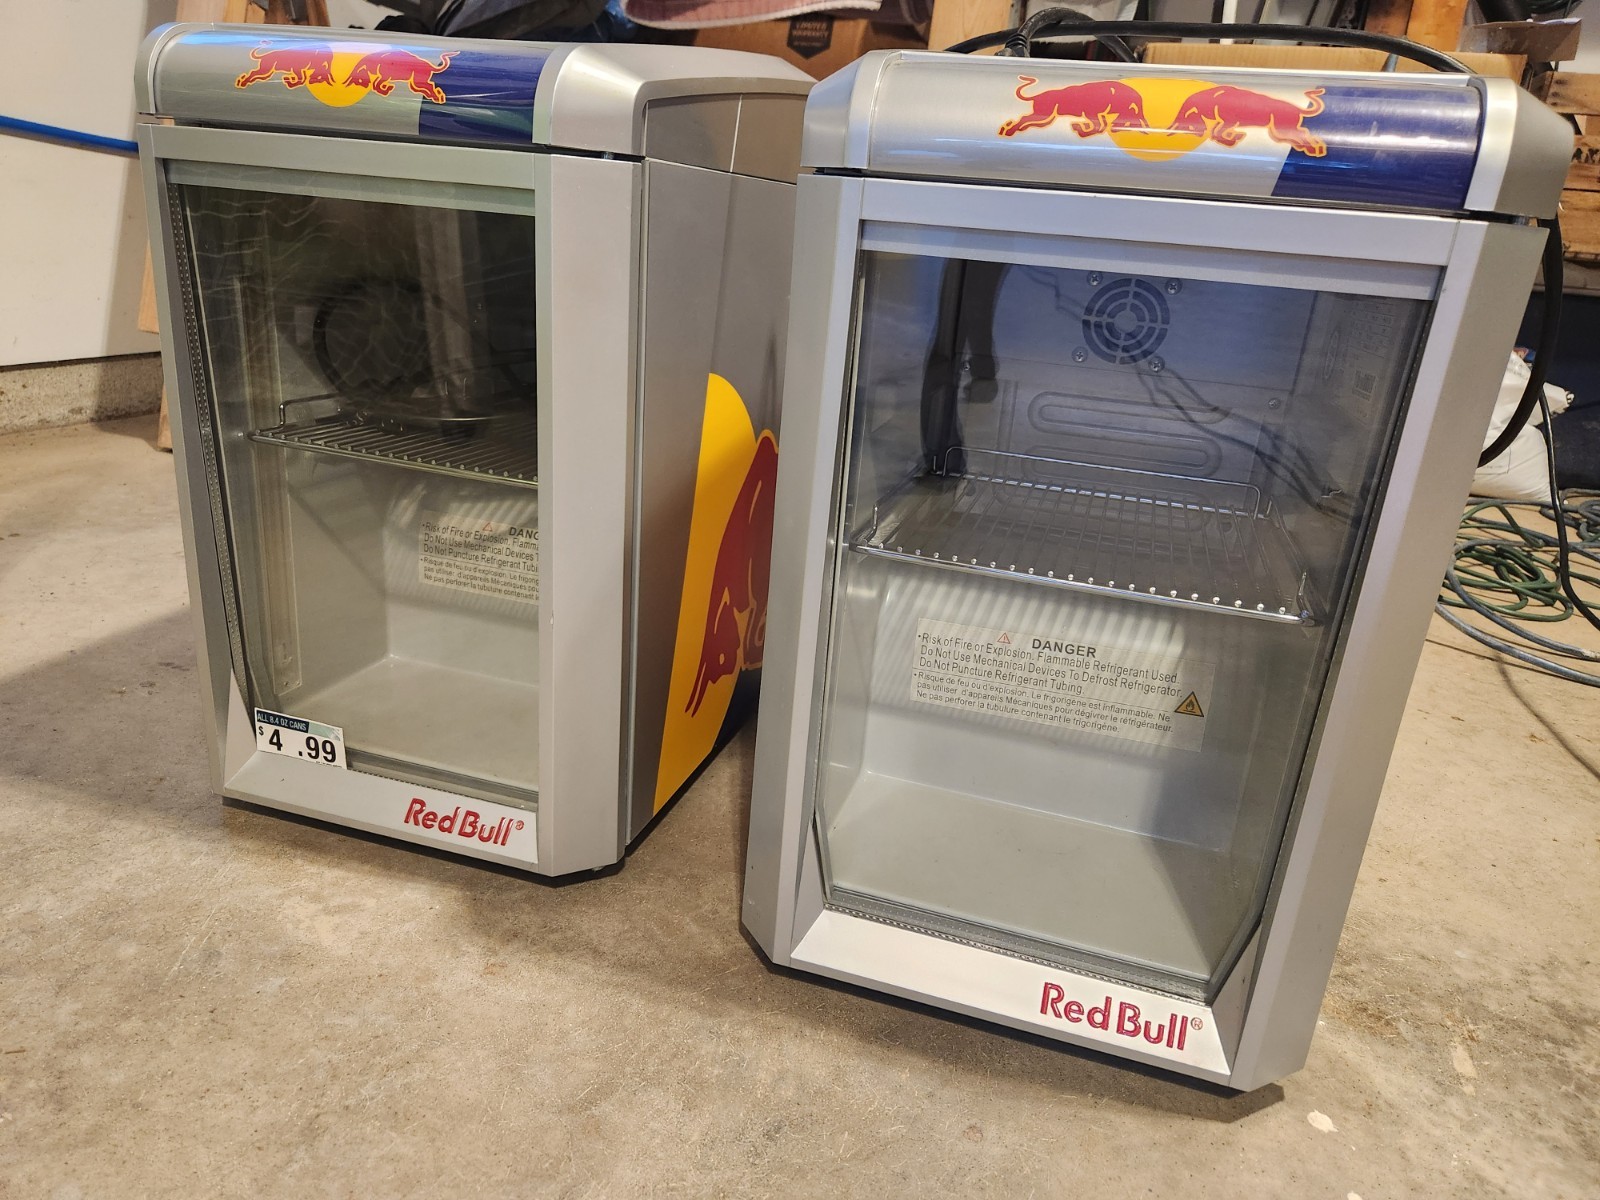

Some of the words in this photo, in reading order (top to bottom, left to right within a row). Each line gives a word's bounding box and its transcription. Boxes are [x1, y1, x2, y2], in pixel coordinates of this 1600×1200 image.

[424, 532, 434, 543] Do
[435, 534, 448, 546] Not
[448, 537, 463, 548] Use
[463, 540, 504, 556] Mechanical
[505, 547, 534, 562] Devices
[441, 525, 449, 535] of
[450, 526, 464, 538] Fire
[465, 531, 473, 539] or
[424, 543, 434, 554] Do
[435, 545, 447, 556] Not
[448, 547, 480, 562] Puncture
[480, 553, 521, 570] Refrigerant
[921, 632, 942, 646] Risk
[943, 636, 955, 648] of
[954, 638, 973, 651] Fire
[974, 642, 984, 652] or
[986, 642, 1034, 660] Explosion.
[1037, 651, 1091, 670] Flammable
[1093, 660, 1149, 680] Refrigerant
[1151, 669, 1180, 685] Used.
[1031, 638, 1097, 658] DANGER
[919, 656, 931, 668] Do
[933, 659, 950, 672] Not
[951, 662, 993, 680] Puncture
[994, 669, 1049, 689] Refrigerant
[1051, 678, 1085, 696] Tubing.
[920, 644, 934, 656] Do
[935, 647, 951, 660] Not
[953, 650, 971, 663] Use
[973, 653, 1026, 672] Mechanical
[1028, 663, 1066, 679] Devices
[1069, 669, 1080, 681] To
[1081, 671, 1118, 688] Defrost
[1120, 677, 1183, 699] Refrigerator.
[916, 689, 927, 698] Ne
[929, 693, 943, 702] pas
[944, 695, 976, 708] perforer
[977, 700, 985, 709] la
[986, 702, 1019, 715] tubulure
[1021, 708, 1061, 723] contenant
[1063, 714, 1071, 724] le
[917, 682, 931, 691] pas
[932, 683, 957, 695] utiliser
[961, 689, 1004, 704] d'appareils
[1054, 704, 1074, 716] pour
[1110, 713, 1118, 723] le
[918, 671, 945, 684] Risque
[946, 675, 956, 684] de
[957, 677, 970, 687] feu
[971, 681, 981, 690] ou
[1031, 690, 1042, 700] Le
[1088, 701, 1101, 711] est
[1102, 702, 1155, 720] inflammable.
[1158, 712, 1171, 722] Ne
[257, 713, 270, 723] ALL
[269, 715, 280, 725] 8.4
[280, 718, 289, 727] OZ
[289, 720, 307, 732] CANS
[258, 725, 264, 736] $
[268, 728, 283, 752] 4
[298, 735, 337, 763] .99
[403, 797, 461, 834] Red
[1039, 981, 1113, 1031] Red
